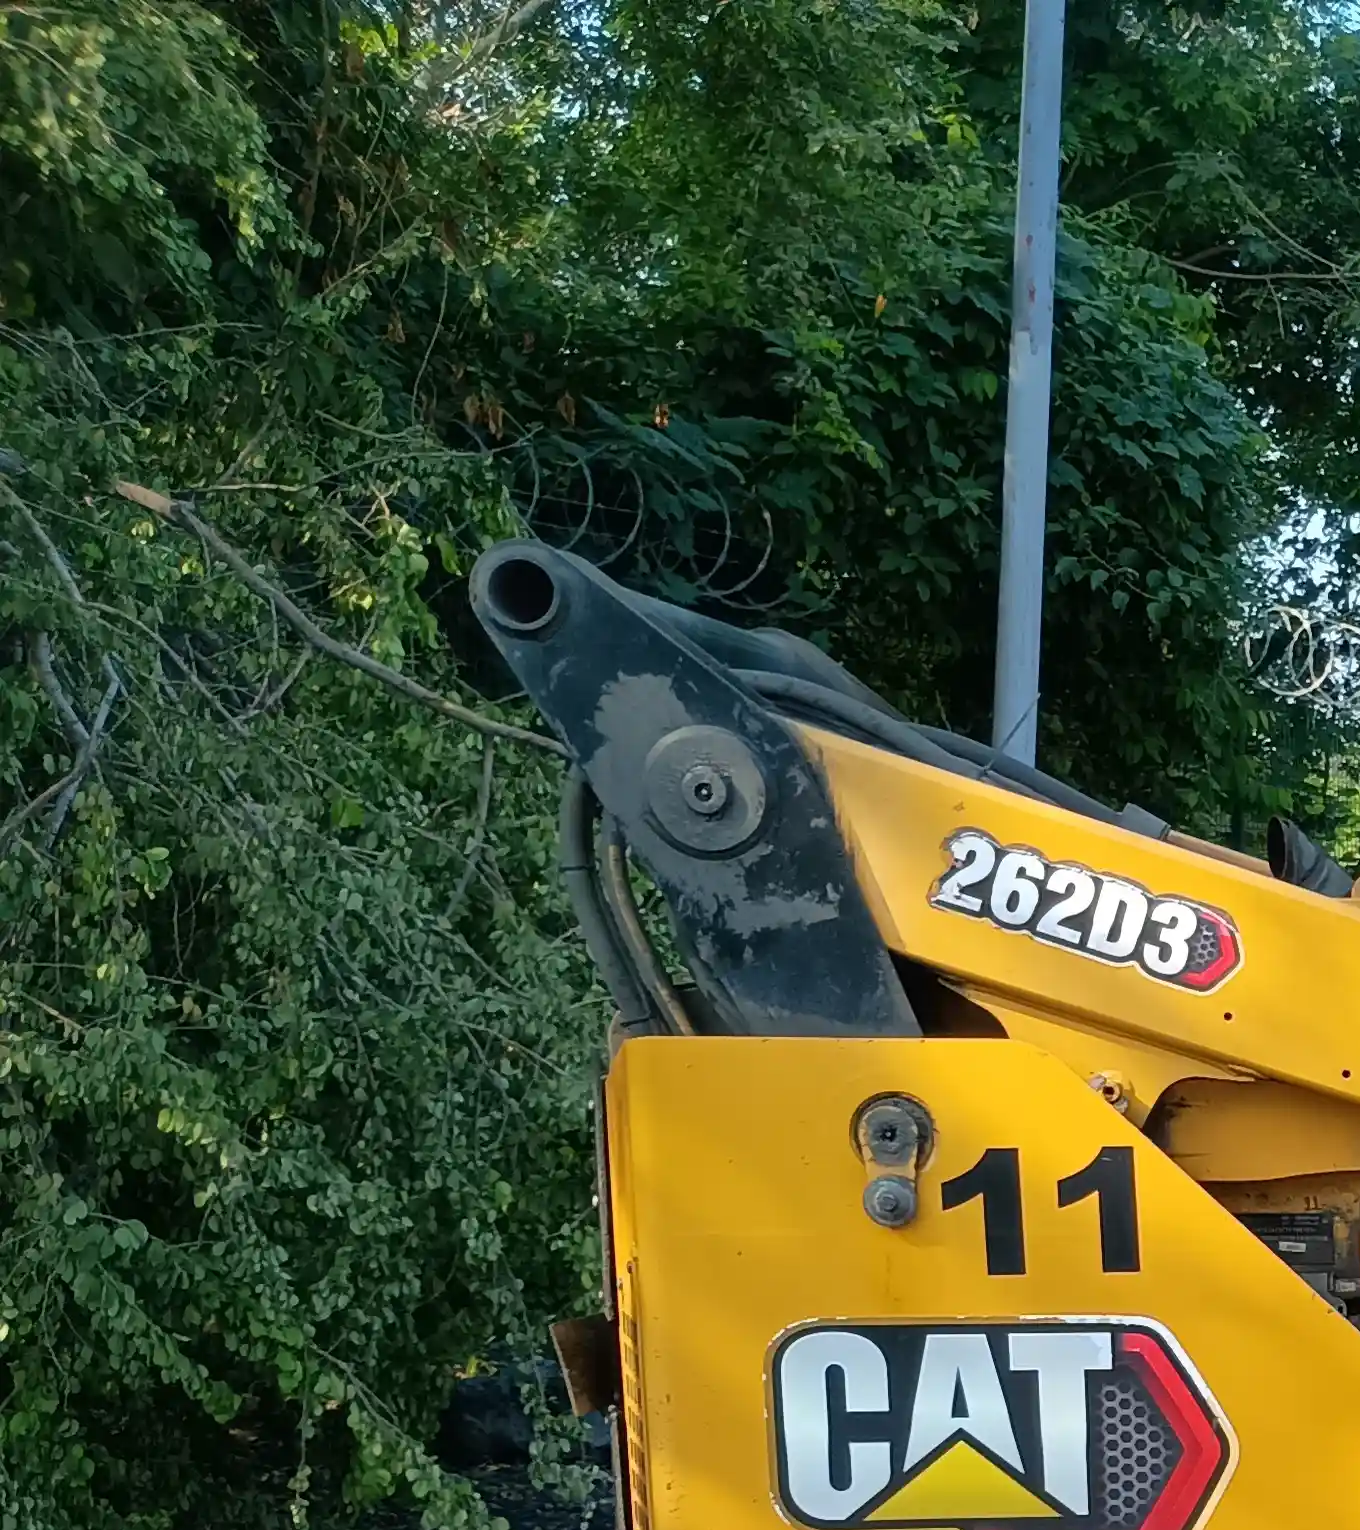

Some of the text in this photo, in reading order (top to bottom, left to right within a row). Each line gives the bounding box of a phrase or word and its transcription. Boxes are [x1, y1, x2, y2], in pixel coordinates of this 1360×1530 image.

[931, 832, 1197, 976] 262D3
[941, 1146, 1141, 1276] 11
[780, 1331, 1113, 1521] CAT
